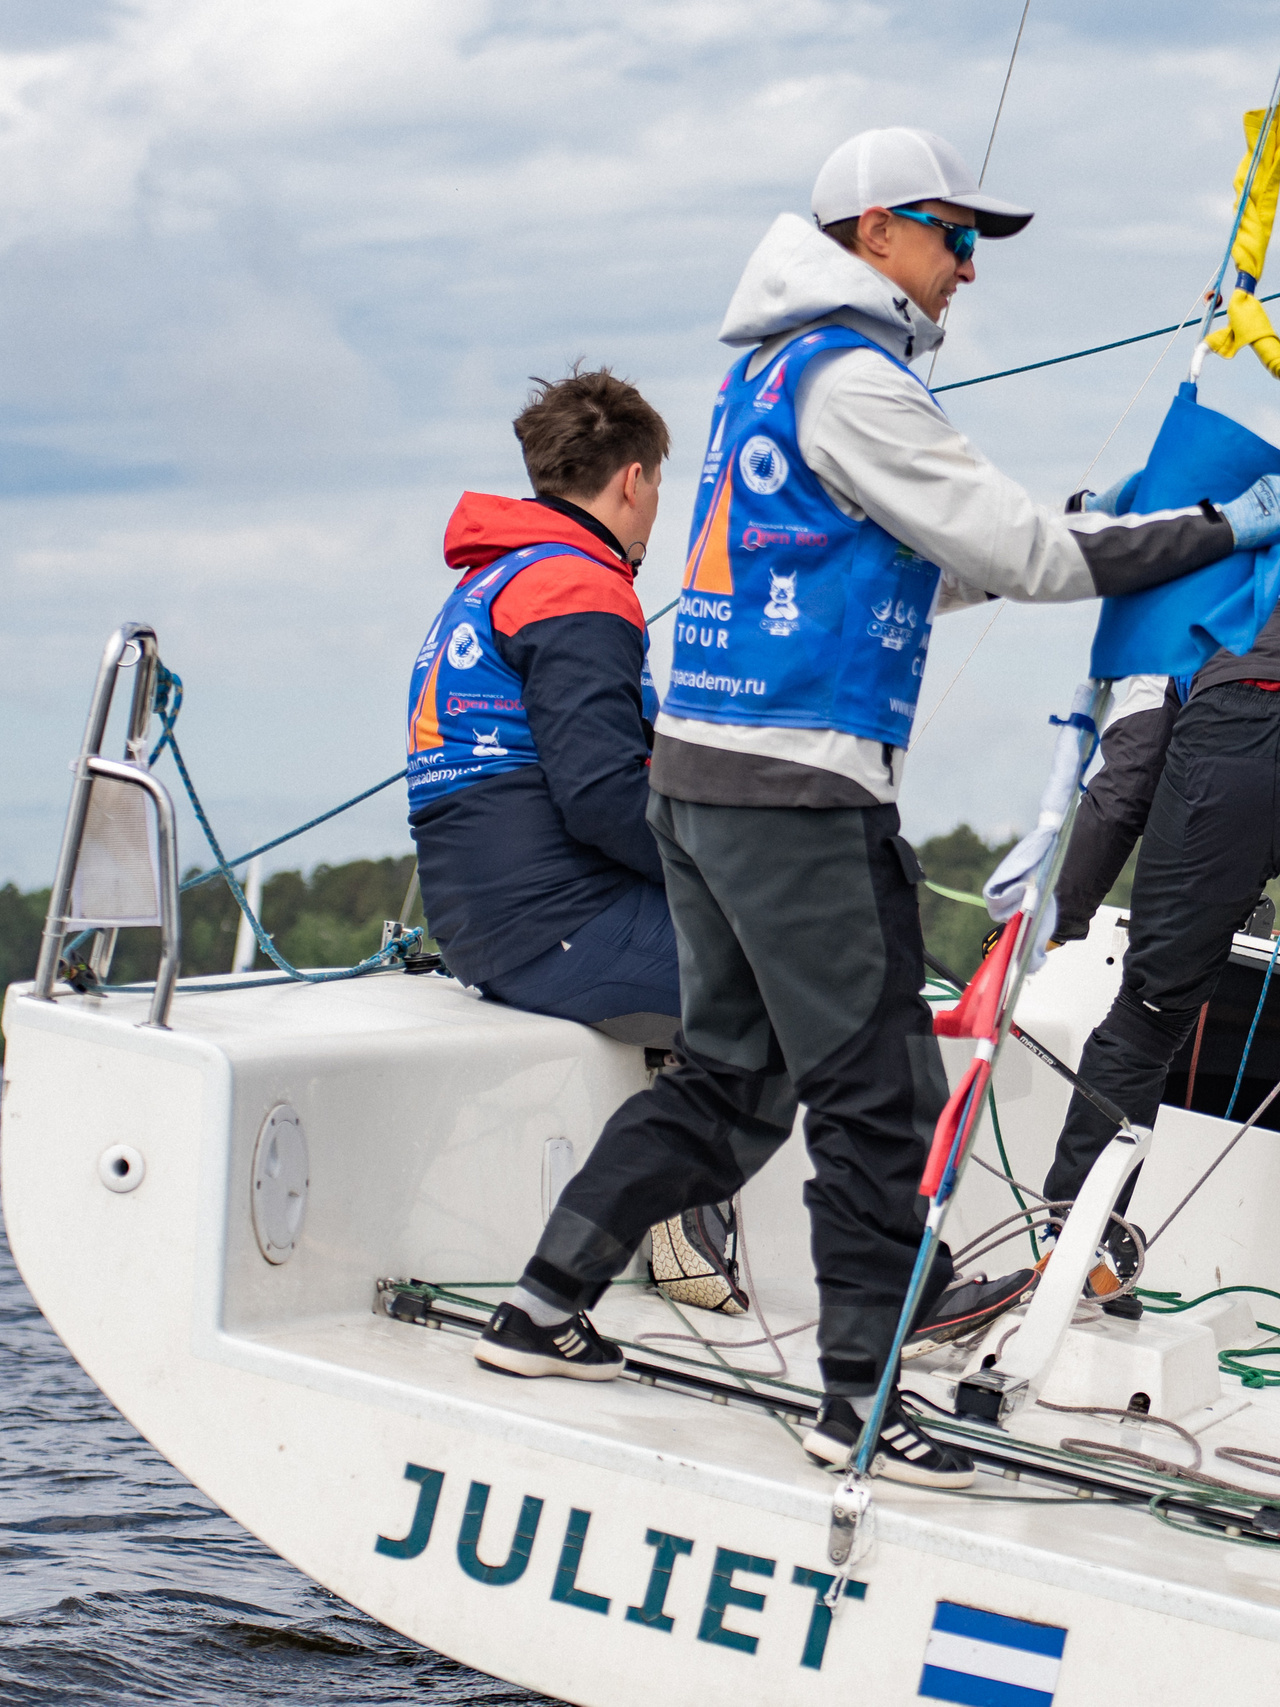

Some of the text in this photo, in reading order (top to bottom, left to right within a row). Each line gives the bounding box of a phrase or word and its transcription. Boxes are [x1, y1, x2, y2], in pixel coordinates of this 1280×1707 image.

[679, 596, 732, 621] RACING
[678, 623, 728, 649] TOUR
[446, 696, 488, 715] Open
[1019, 1035, 1054, 1065] MASTER
[374, 1462, 868, 1671] JULIET
